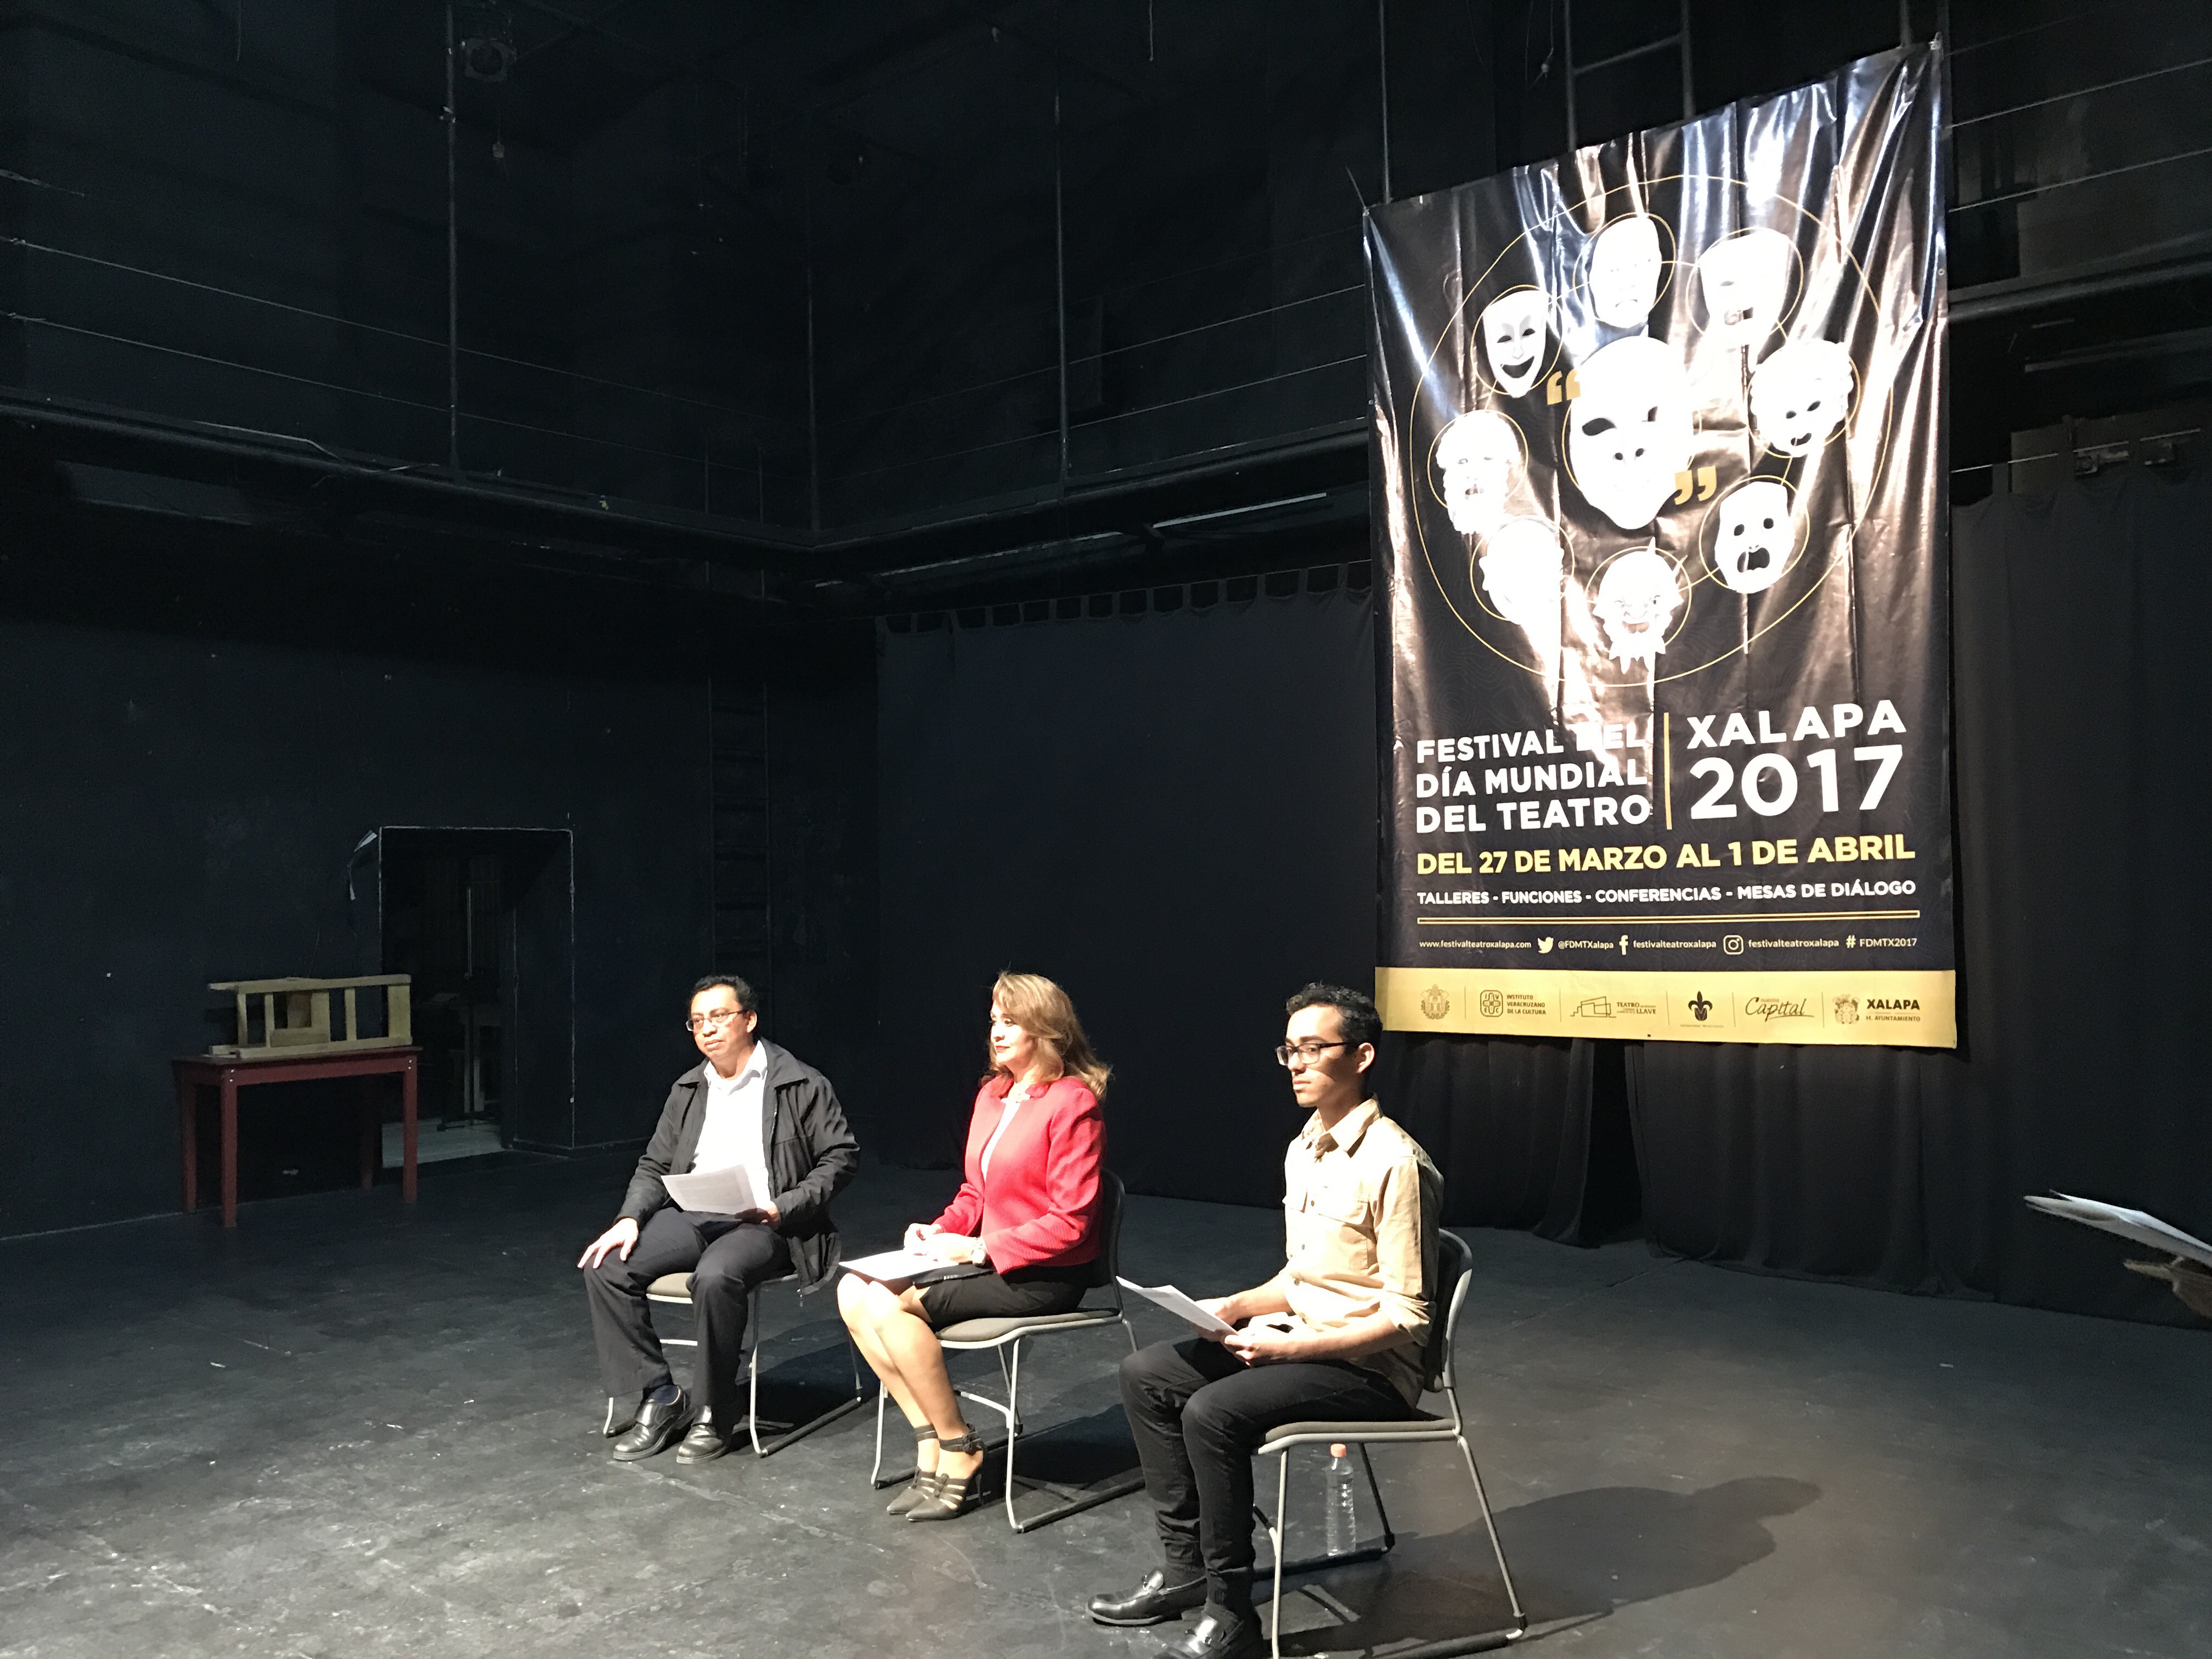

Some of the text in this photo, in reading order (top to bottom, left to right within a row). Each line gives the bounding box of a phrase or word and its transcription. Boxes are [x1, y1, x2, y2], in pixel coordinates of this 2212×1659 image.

[1687, 699, 1906, 749] XALAPA
[1417, 729, 1564, 763] FESTIVAL
[1416, 759, 1647, 798] DÍA MUNDIAL
[1690, 744, 1903, 819] 2017
[1416, 794, 1650, 833] DEL TEATRO
[1417, 834, 1916, 874] DEL 27 DE MARZO AL 1 DE ABRIL
[1417, 891, 1489, 905] TALLERES
[1502, 890, 1582, 904] FUNCIONES
[1595, 887, 1722, 902] CONFERENCIAS
[1737, 884, 1797, 900] MESAS
[1801, 883, 1826, 898] DE
[1831, 878, 1916, 897] DIÁLOGO
[1419, 940, 1532, 950] www.festivalteatroxalapa.com
[1558, 941, 1614, 950] @FDMTXalapa
[1633, 940, 1716, 949] festivalteatroxalapa
[1748, 938, 1839, 949] festivalteatroxalapa
[1859, 938, 1917, 947] FDMTX2017
[1745, 996, 1807, 1023] Capital
[1867, 999, 1920, 1010] XALAPA
